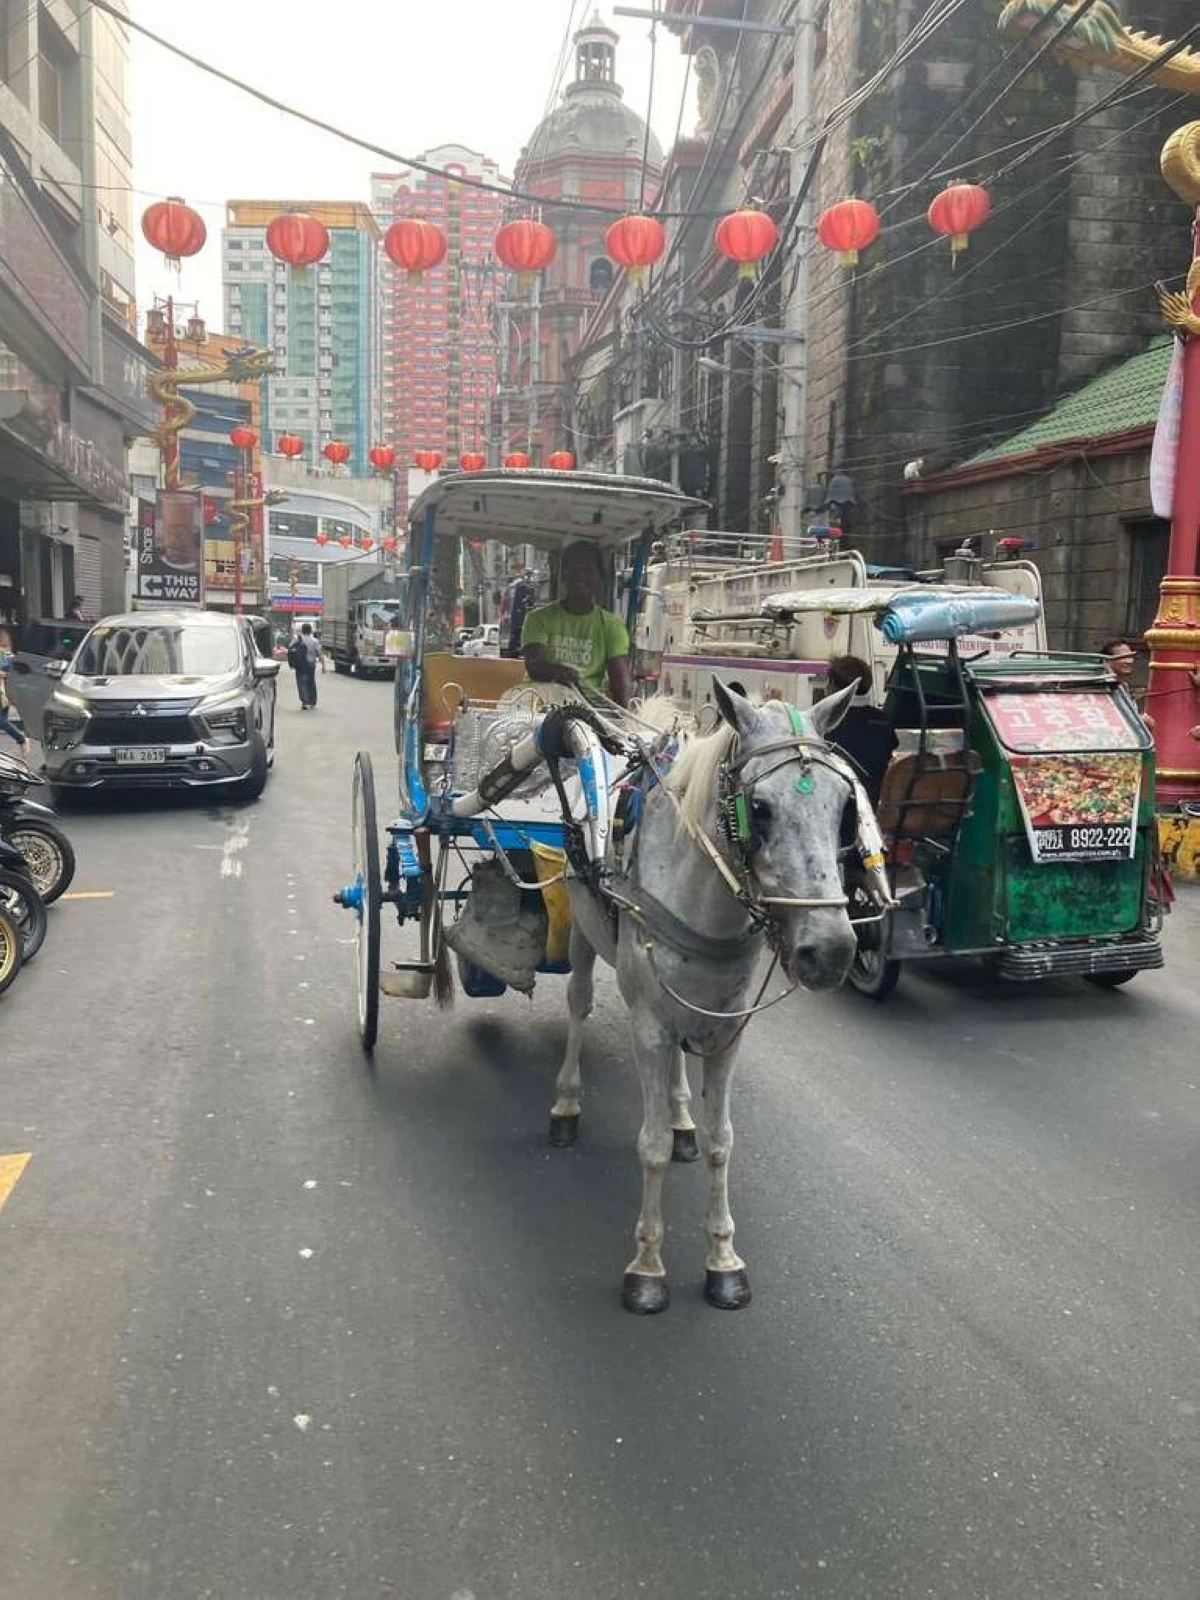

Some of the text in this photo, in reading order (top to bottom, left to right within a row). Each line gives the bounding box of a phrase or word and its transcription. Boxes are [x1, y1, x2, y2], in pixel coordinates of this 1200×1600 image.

[140, 526, 153, 564] Share
[163, 574, 198, 587] THIS
[164, 587, 198, 599] WAY
[1038, 826, 1132, 850] PIZZA 8922-222
